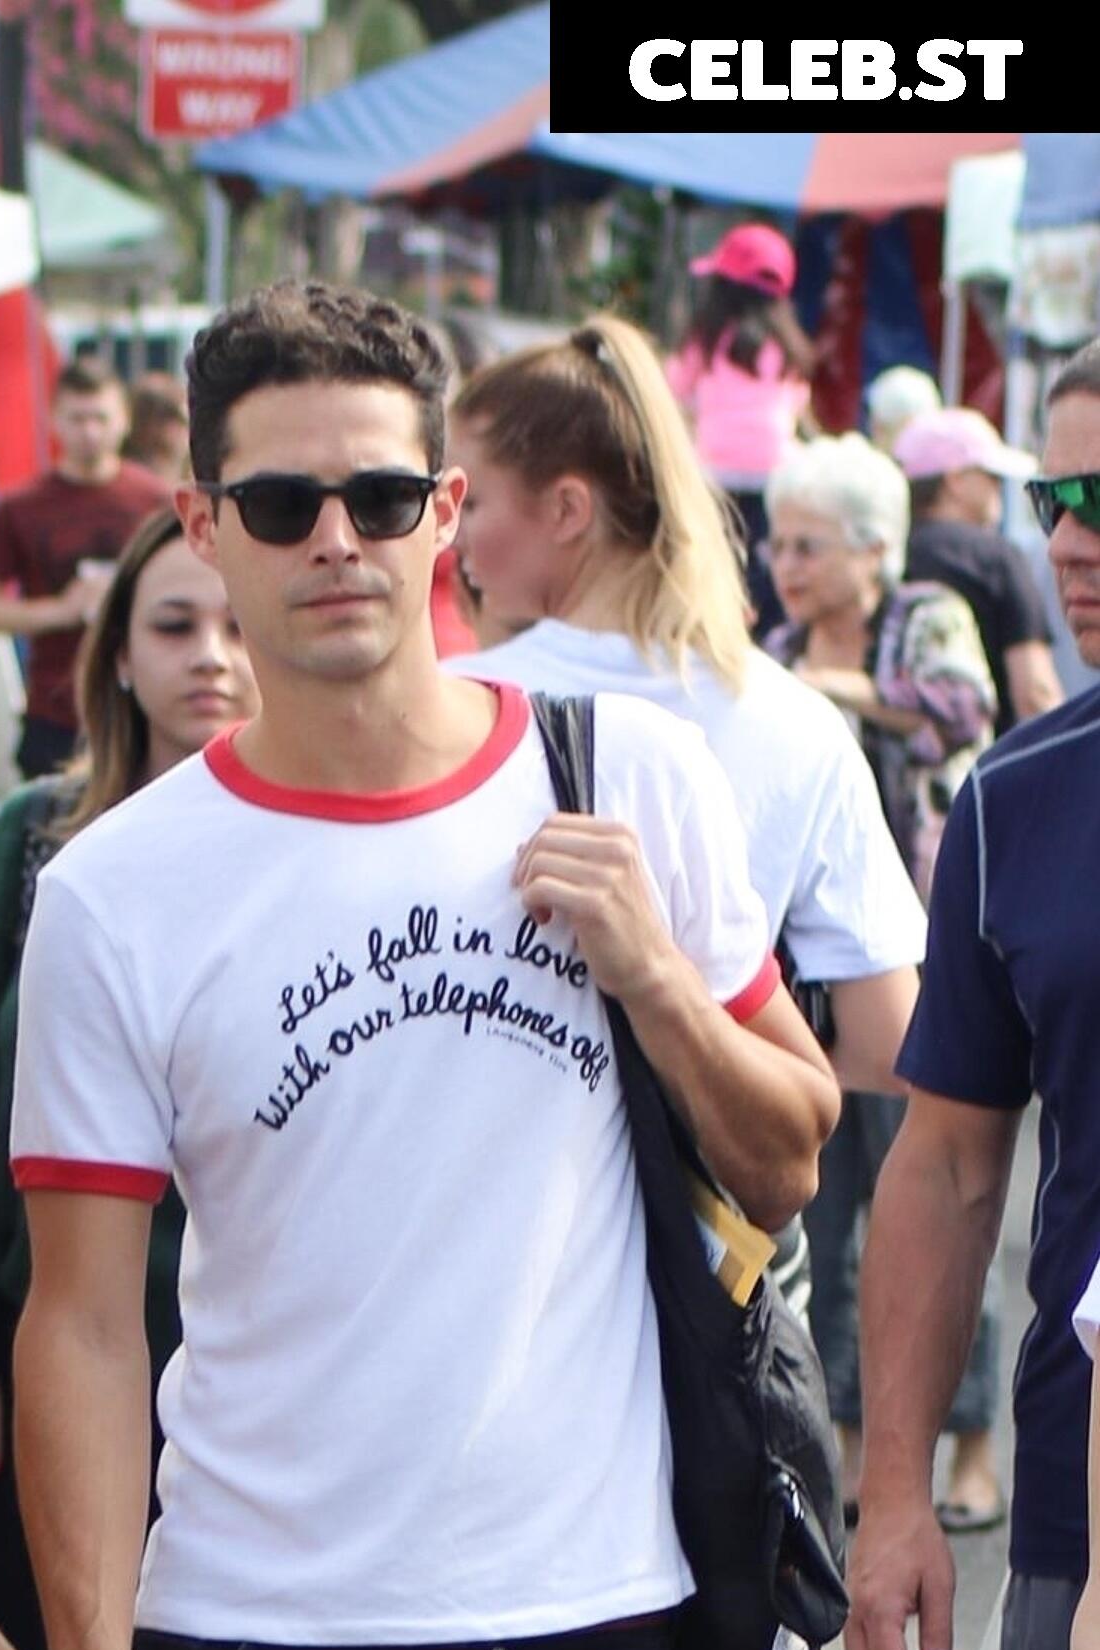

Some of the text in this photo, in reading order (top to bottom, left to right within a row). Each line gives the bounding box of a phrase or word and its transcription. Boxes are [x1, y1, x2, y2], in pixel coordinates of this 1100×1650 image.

[157, 41, 288, 80] WRONG
[177, 88, 264, 129] WAY
[281, 905, 588, 1034] Let's fall in love
[327, 1008, 394, 1056] our
[401, 972, 569, 1048] telephones
[570, 1034, 610, 1093] off
